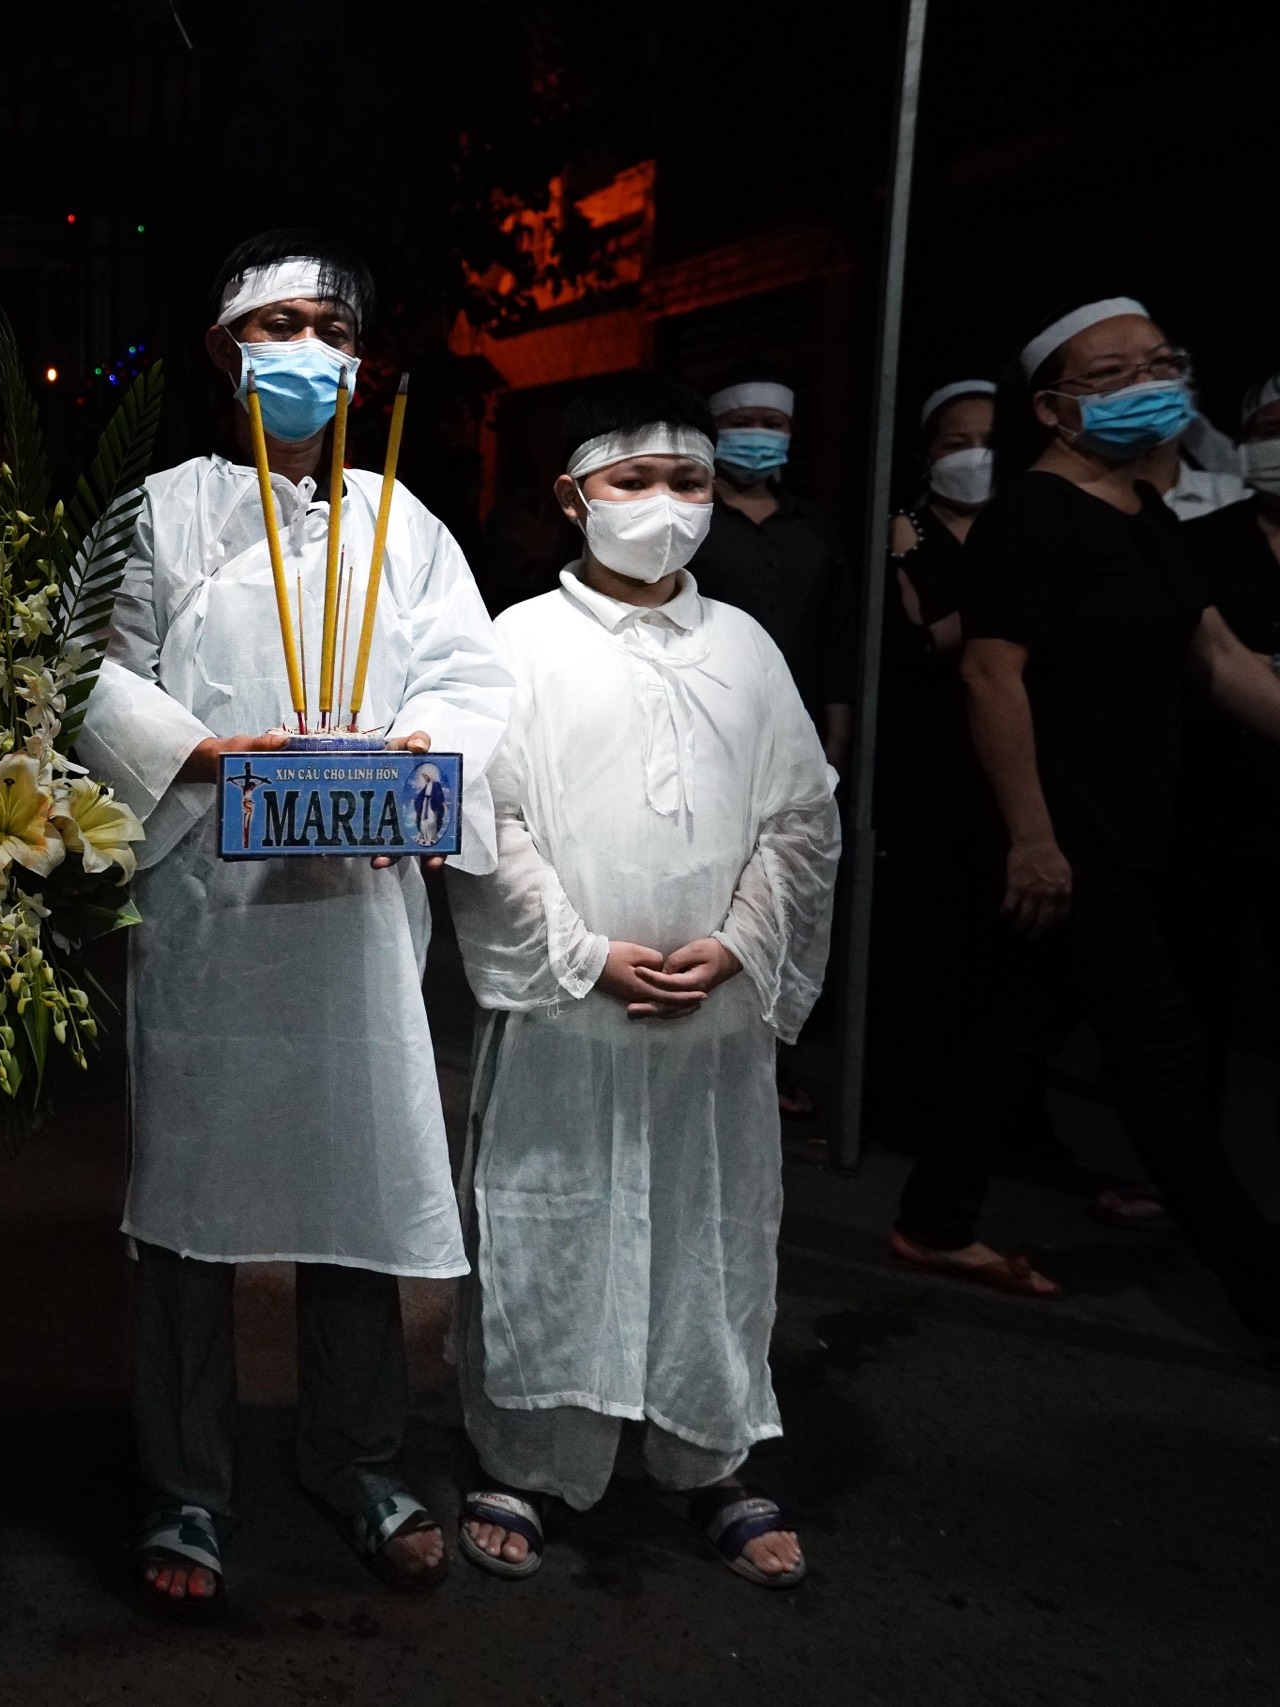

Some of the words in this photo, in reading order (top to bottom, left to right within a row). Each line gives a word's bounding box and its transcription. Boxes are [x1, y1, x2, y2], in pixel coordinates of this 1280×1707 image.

[275, 768, 296, 781] XIN
[298, 762, 321, 781] CẦU
[323, 768, 345, 781] CHO
[348, 768, 373, 781] LINH
[261, 790, 405, 847] MARIA
